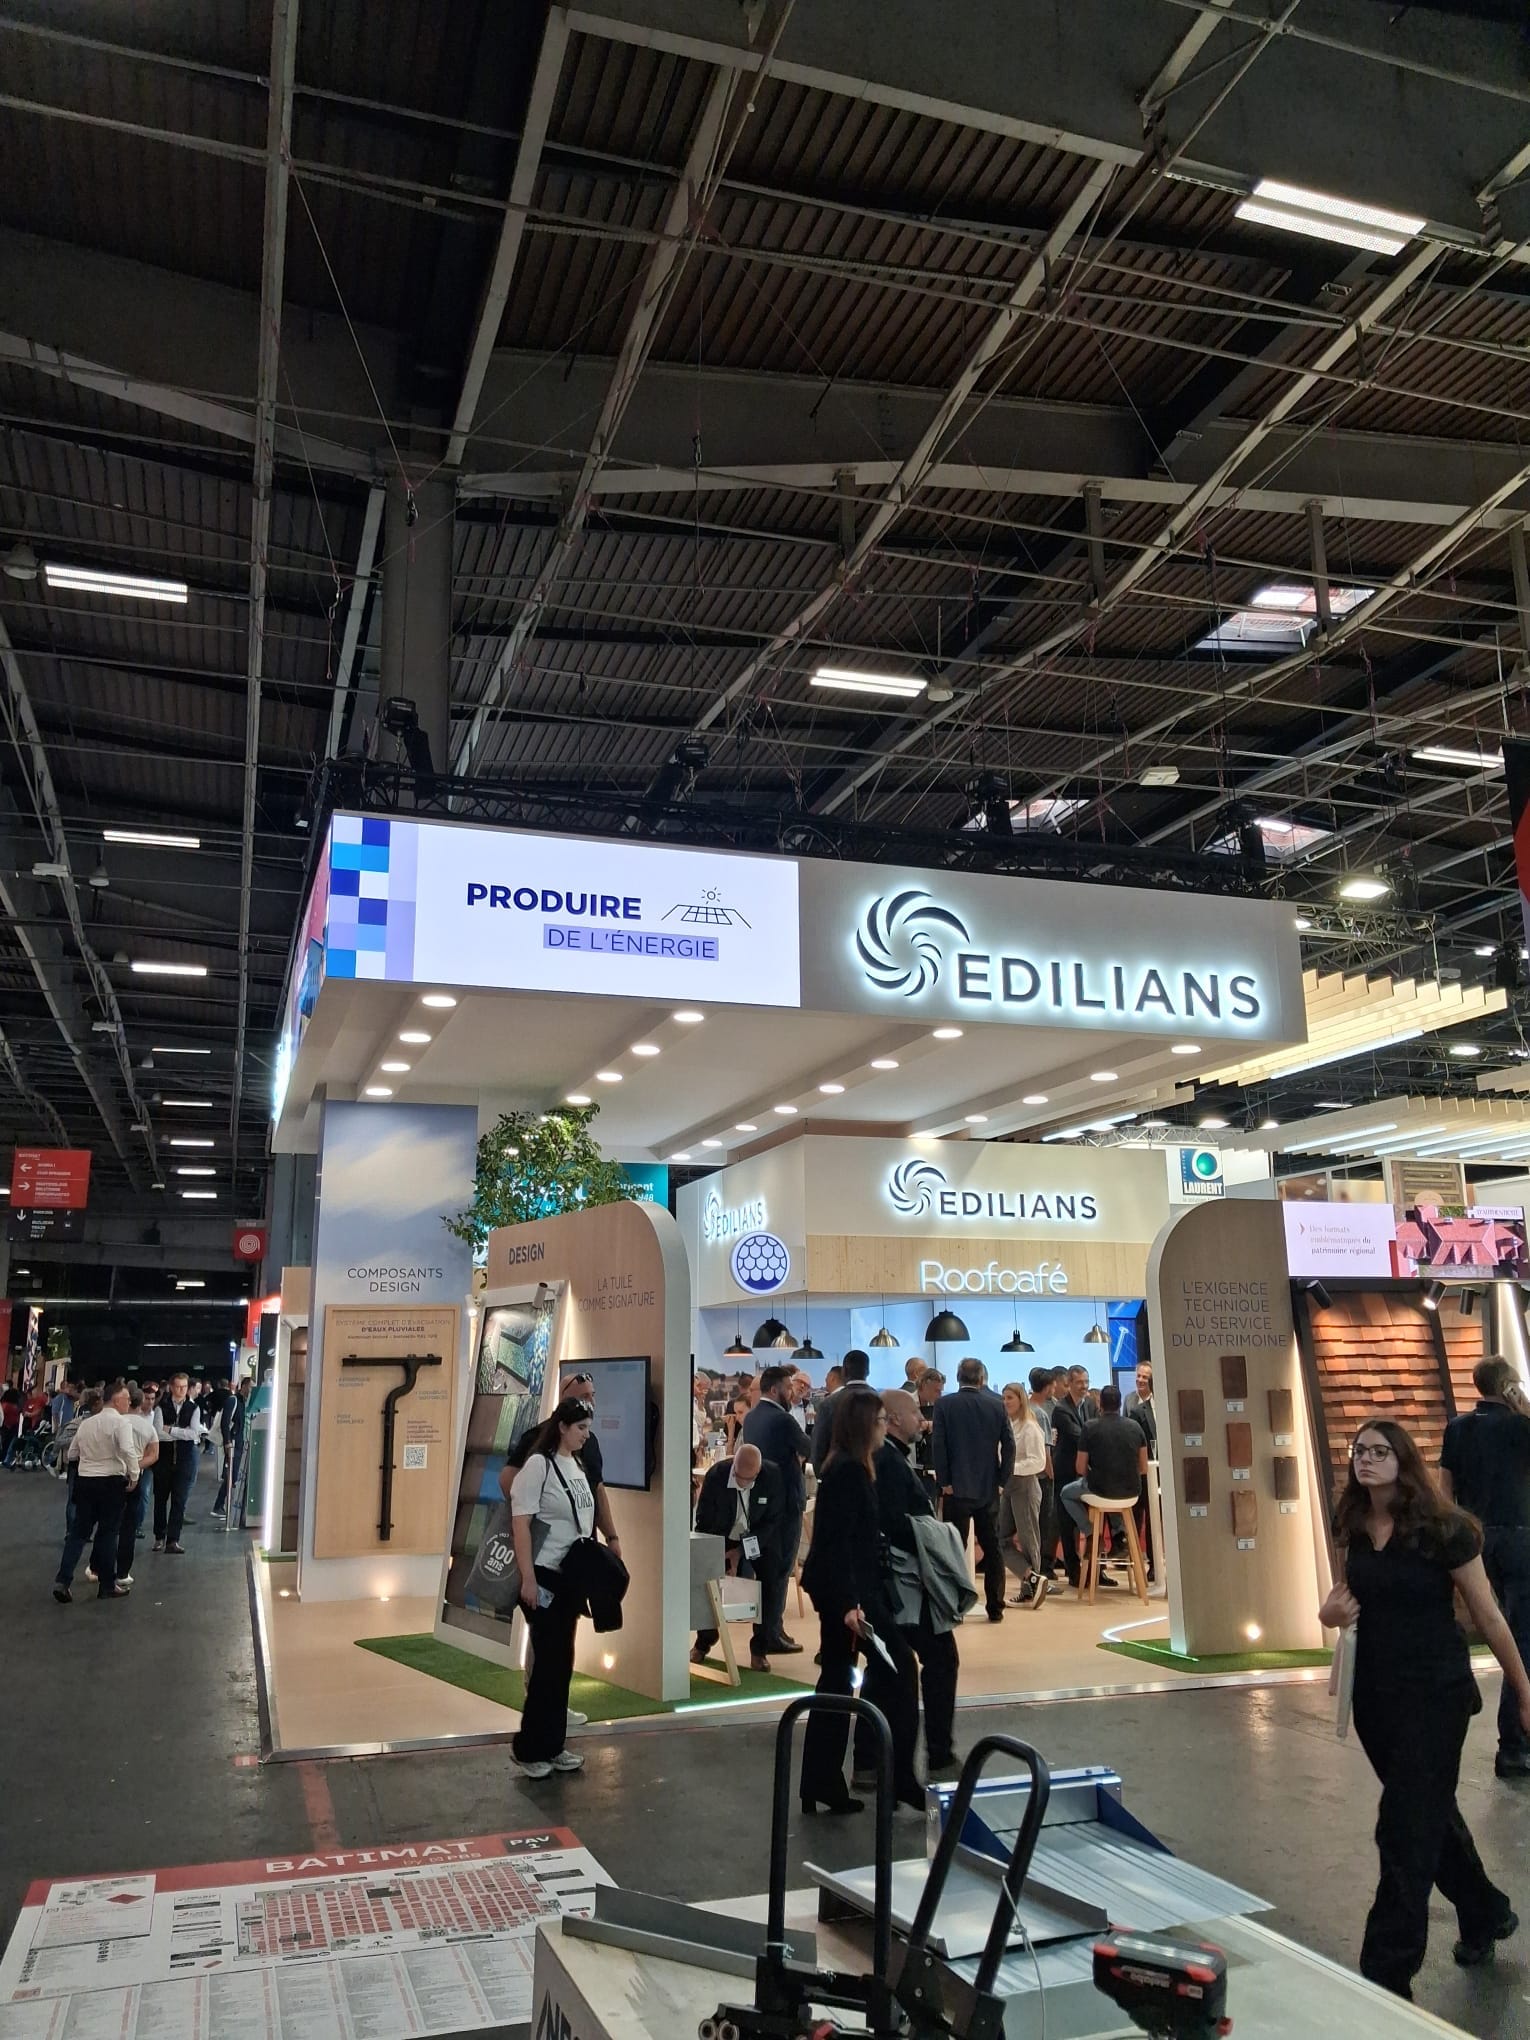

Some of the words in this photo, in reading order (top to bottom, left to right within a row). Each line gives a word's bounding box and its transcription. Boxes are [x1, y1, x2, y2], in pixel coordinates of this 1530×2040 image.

[466, 882, 642, 920] PRODUIRE
[548, 928, 580, 949] DE
[590, 931, 716, 959] L'ÉNERGIE
[958, 953, 1261, 1019] EDILIANS
[1183, 1182, 1224, 1195] LAURENT
[939, 1191, 1097, 1219] EDILIANS
[717, 1202, 763, 1238] EDILIANS
[1362, 1236, 1371, 1244] du
[509, 1242, 545, 1265] DESIGN
[347, 1268, 443, 1279] COMPOSANTS
[920, 1261, 1068, 1294] Roofcafé
[369, 1281, 420, 1293] DESIGN
[597, 1279, 609, 1292] LA
[610, 1275, 633, 1290] TUILE
[1183, 1281, 1268, 1295] L'EXIGENCE
[578, 1296, 606, 1312] COMME
[608, 1291, 655, 1309] SIGNATURE
[1184, 1298, 1270, 1313] TECHNIQUE
[1185, 1316, 1206, 1329] AU
[1211, 1316, 1273, 1330] SERVICE
[1172, 1333, 1193, 1347] DU
[1198, 1333, 1288, 1347] PATRIMOINE
[489, 1541, 515, 1565] 100
[487, 1557, 505, 1571] ans
[510, 1836, 549, 1846] PAV
[266, 1842, 475, 1873] BATIMAT
